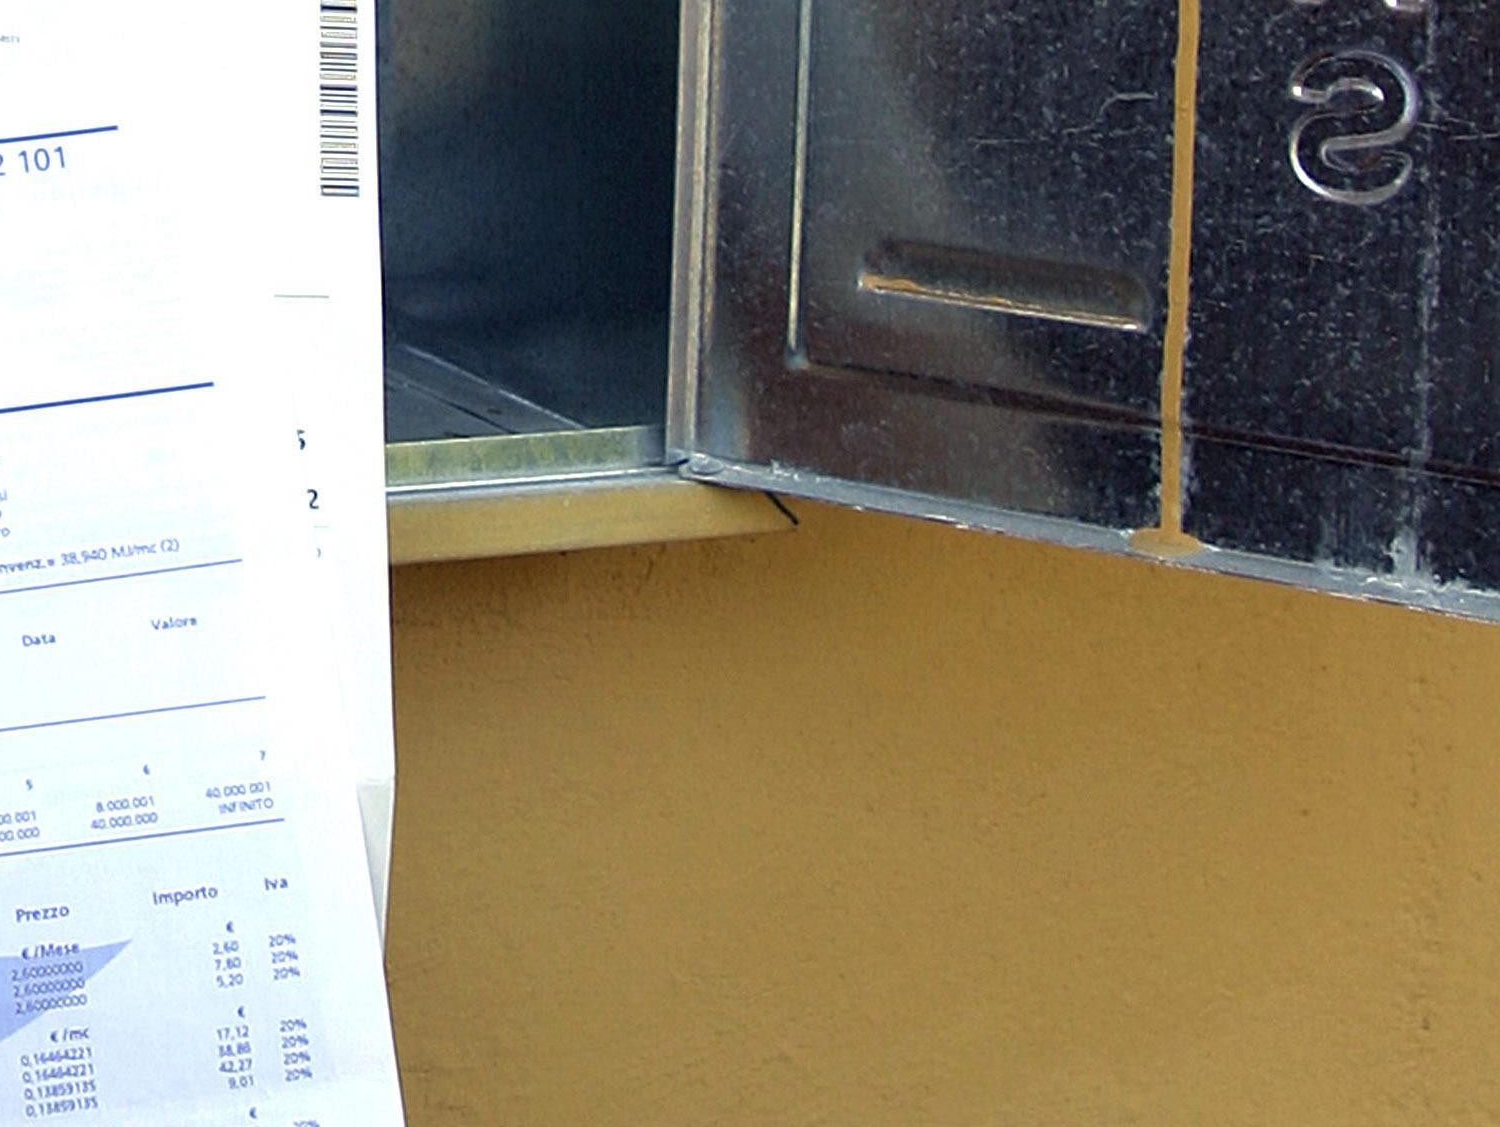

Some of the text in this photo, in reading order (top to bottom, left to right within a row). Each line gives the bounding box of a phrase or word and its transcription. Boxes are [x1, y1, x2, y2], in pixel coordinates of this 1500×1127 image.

[19, 146, 67, 173] 101
[151, 615, 197, 631] Valore
[21, 631, 56, 648] Data
[263, 875, 289, 891] Iva
[151, 884, 219, 909] Importo
[15, 903, 70, 922] Prezzo
